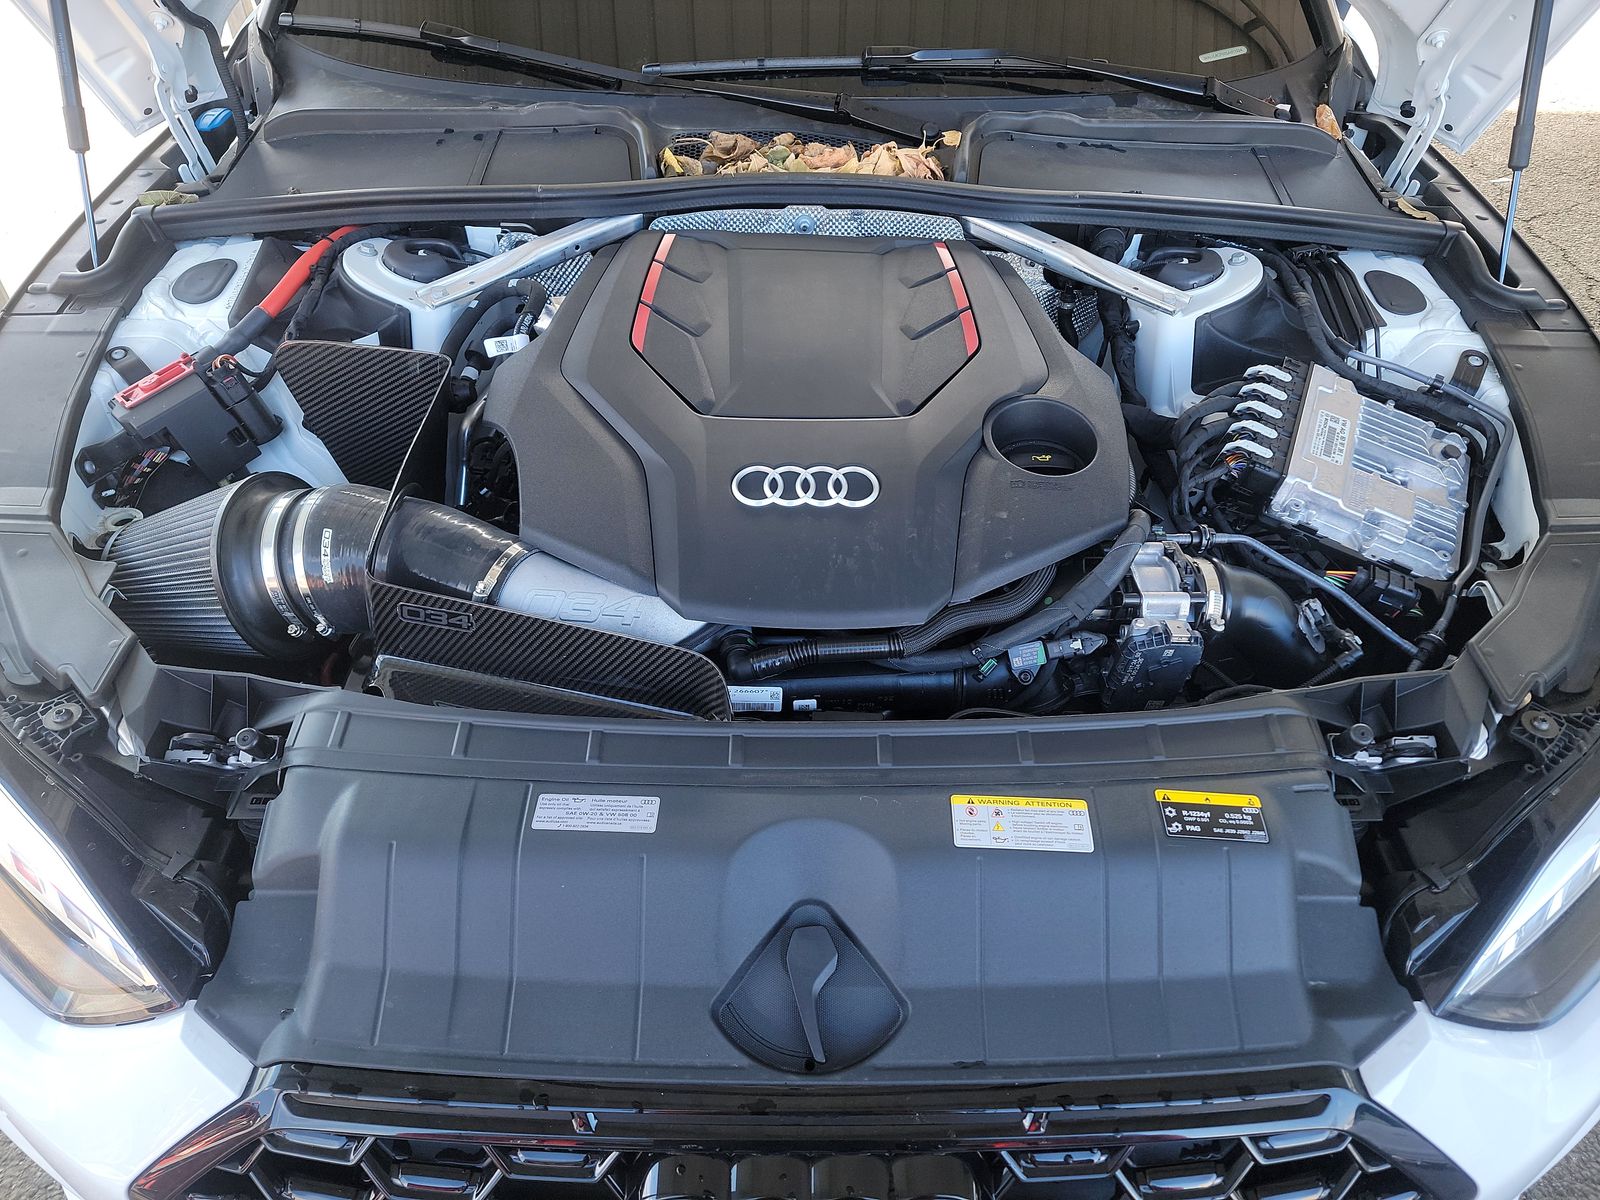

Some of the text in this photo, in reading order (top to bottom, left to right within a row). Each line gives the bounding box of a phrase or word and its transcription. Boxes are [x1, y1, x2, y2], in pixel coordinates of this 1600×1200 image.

[322, 530, 333, 558] 034
[401, 605, 473, 630] 034
[521, 588, 645, 626] 034
[977, 798, 1073, 808] WARNING ATTENTION
